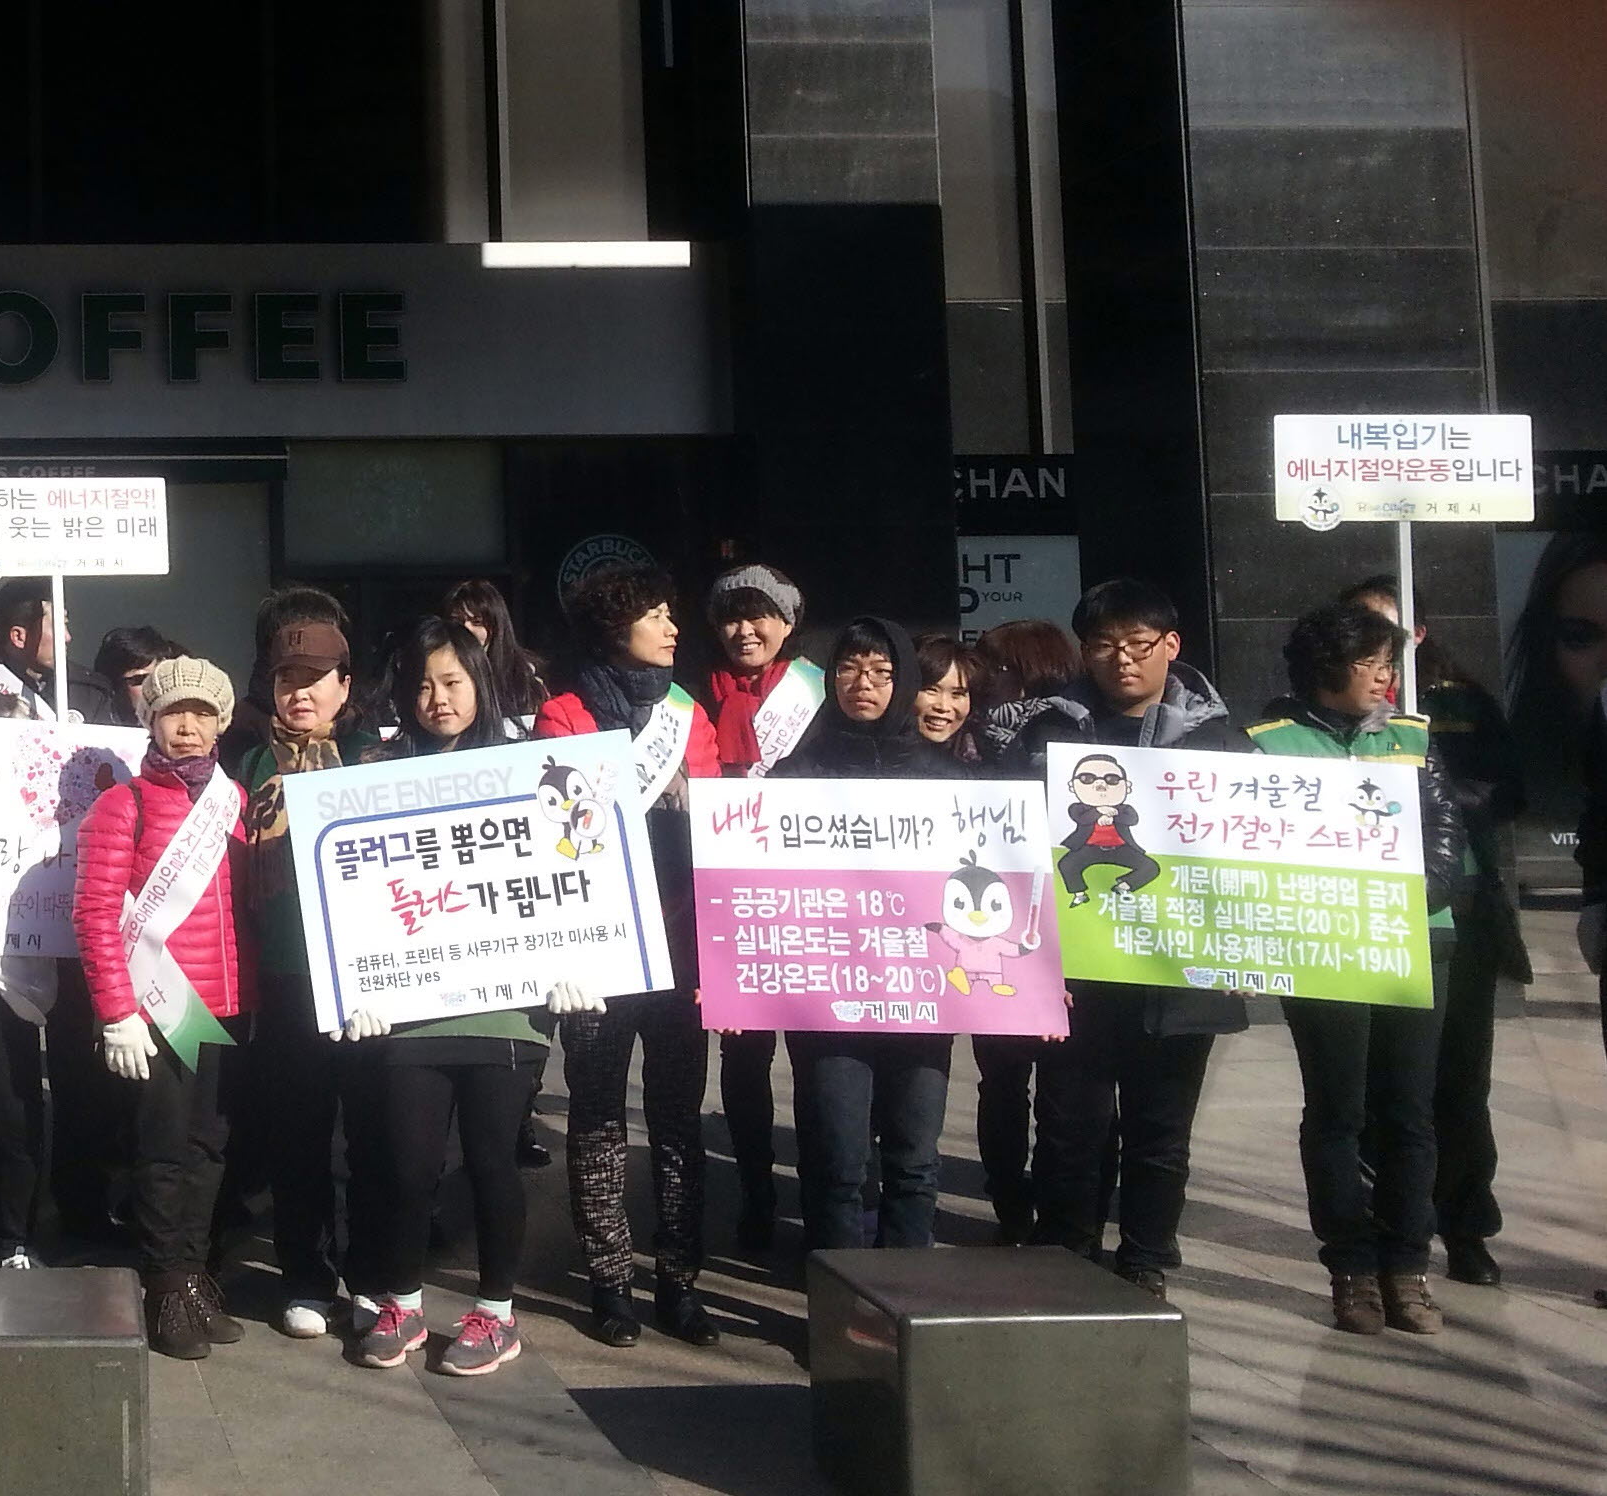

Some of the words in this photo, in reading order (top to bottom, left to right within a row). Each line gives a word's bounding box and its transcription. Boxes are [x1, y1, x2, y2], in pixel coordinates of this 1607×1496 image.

[1337, 422, 1471, 450] 내복입기는
[1287, 458, 1522, 482] 에너지절약운동입니다
[48, 488, 156, 510] 에너지절약!
[8, 516, 51, 538] 웃는
[63, 516, 105, 538] 밝은
[117, 516, 157, 537] 미래
[982, 591, 1023, 602] YOUR
[316, 784, 391, 821] SAVE
[394, 767, 514, 811] ENERGY
[1156, 771, 1217, 803] 우린
[1229, 774, 1323, 812] 겨울철
[712, 791, 770, 852] 내복
[779, 814, 935, 850] 입으셨습니까?
[951, 794, 1028, 848] 행님!
[1166, 812, 1295, 851] 전기절약
[1305, 825, 1400, 862] 스타일
[334, 827, 442, 881] 플러그를
[450, 816, 532, 866] 뽑으면
[386, 878, 499, 936] 플러스가
[505, 869, 591, 919] 됩니다
[731, 887, 848, 918] 공공기관은
[1276, 873, 1359, 906] 난방영업
[1366, 879, 1408, 911] 금지
[1098, 892, 1157, 923] 겨울철
[1166, 896, 1205, 927] 적정
[1368, 912, 1411, 944] 준수
[404, 943, 444, 966] 프린터
[448, 943, 463, 961] 등
[466, 937, 520, 958] 사무기구
[523, 930, 564, 952] 장기간
[568, 925, 609, 944] 미사용
[614, 922, 627, 939] 시
[734, 924, 851, 957] 실내온도는
[858, 925, 929, 958] 겨울철
[1114, 926, 1195, 958] 네온사인
[1202, 932, 1411, 977] 사용제한(17시~19시)
[358, 972, 411, 992] 전원차단
[415, 972, 441, 985] yes
